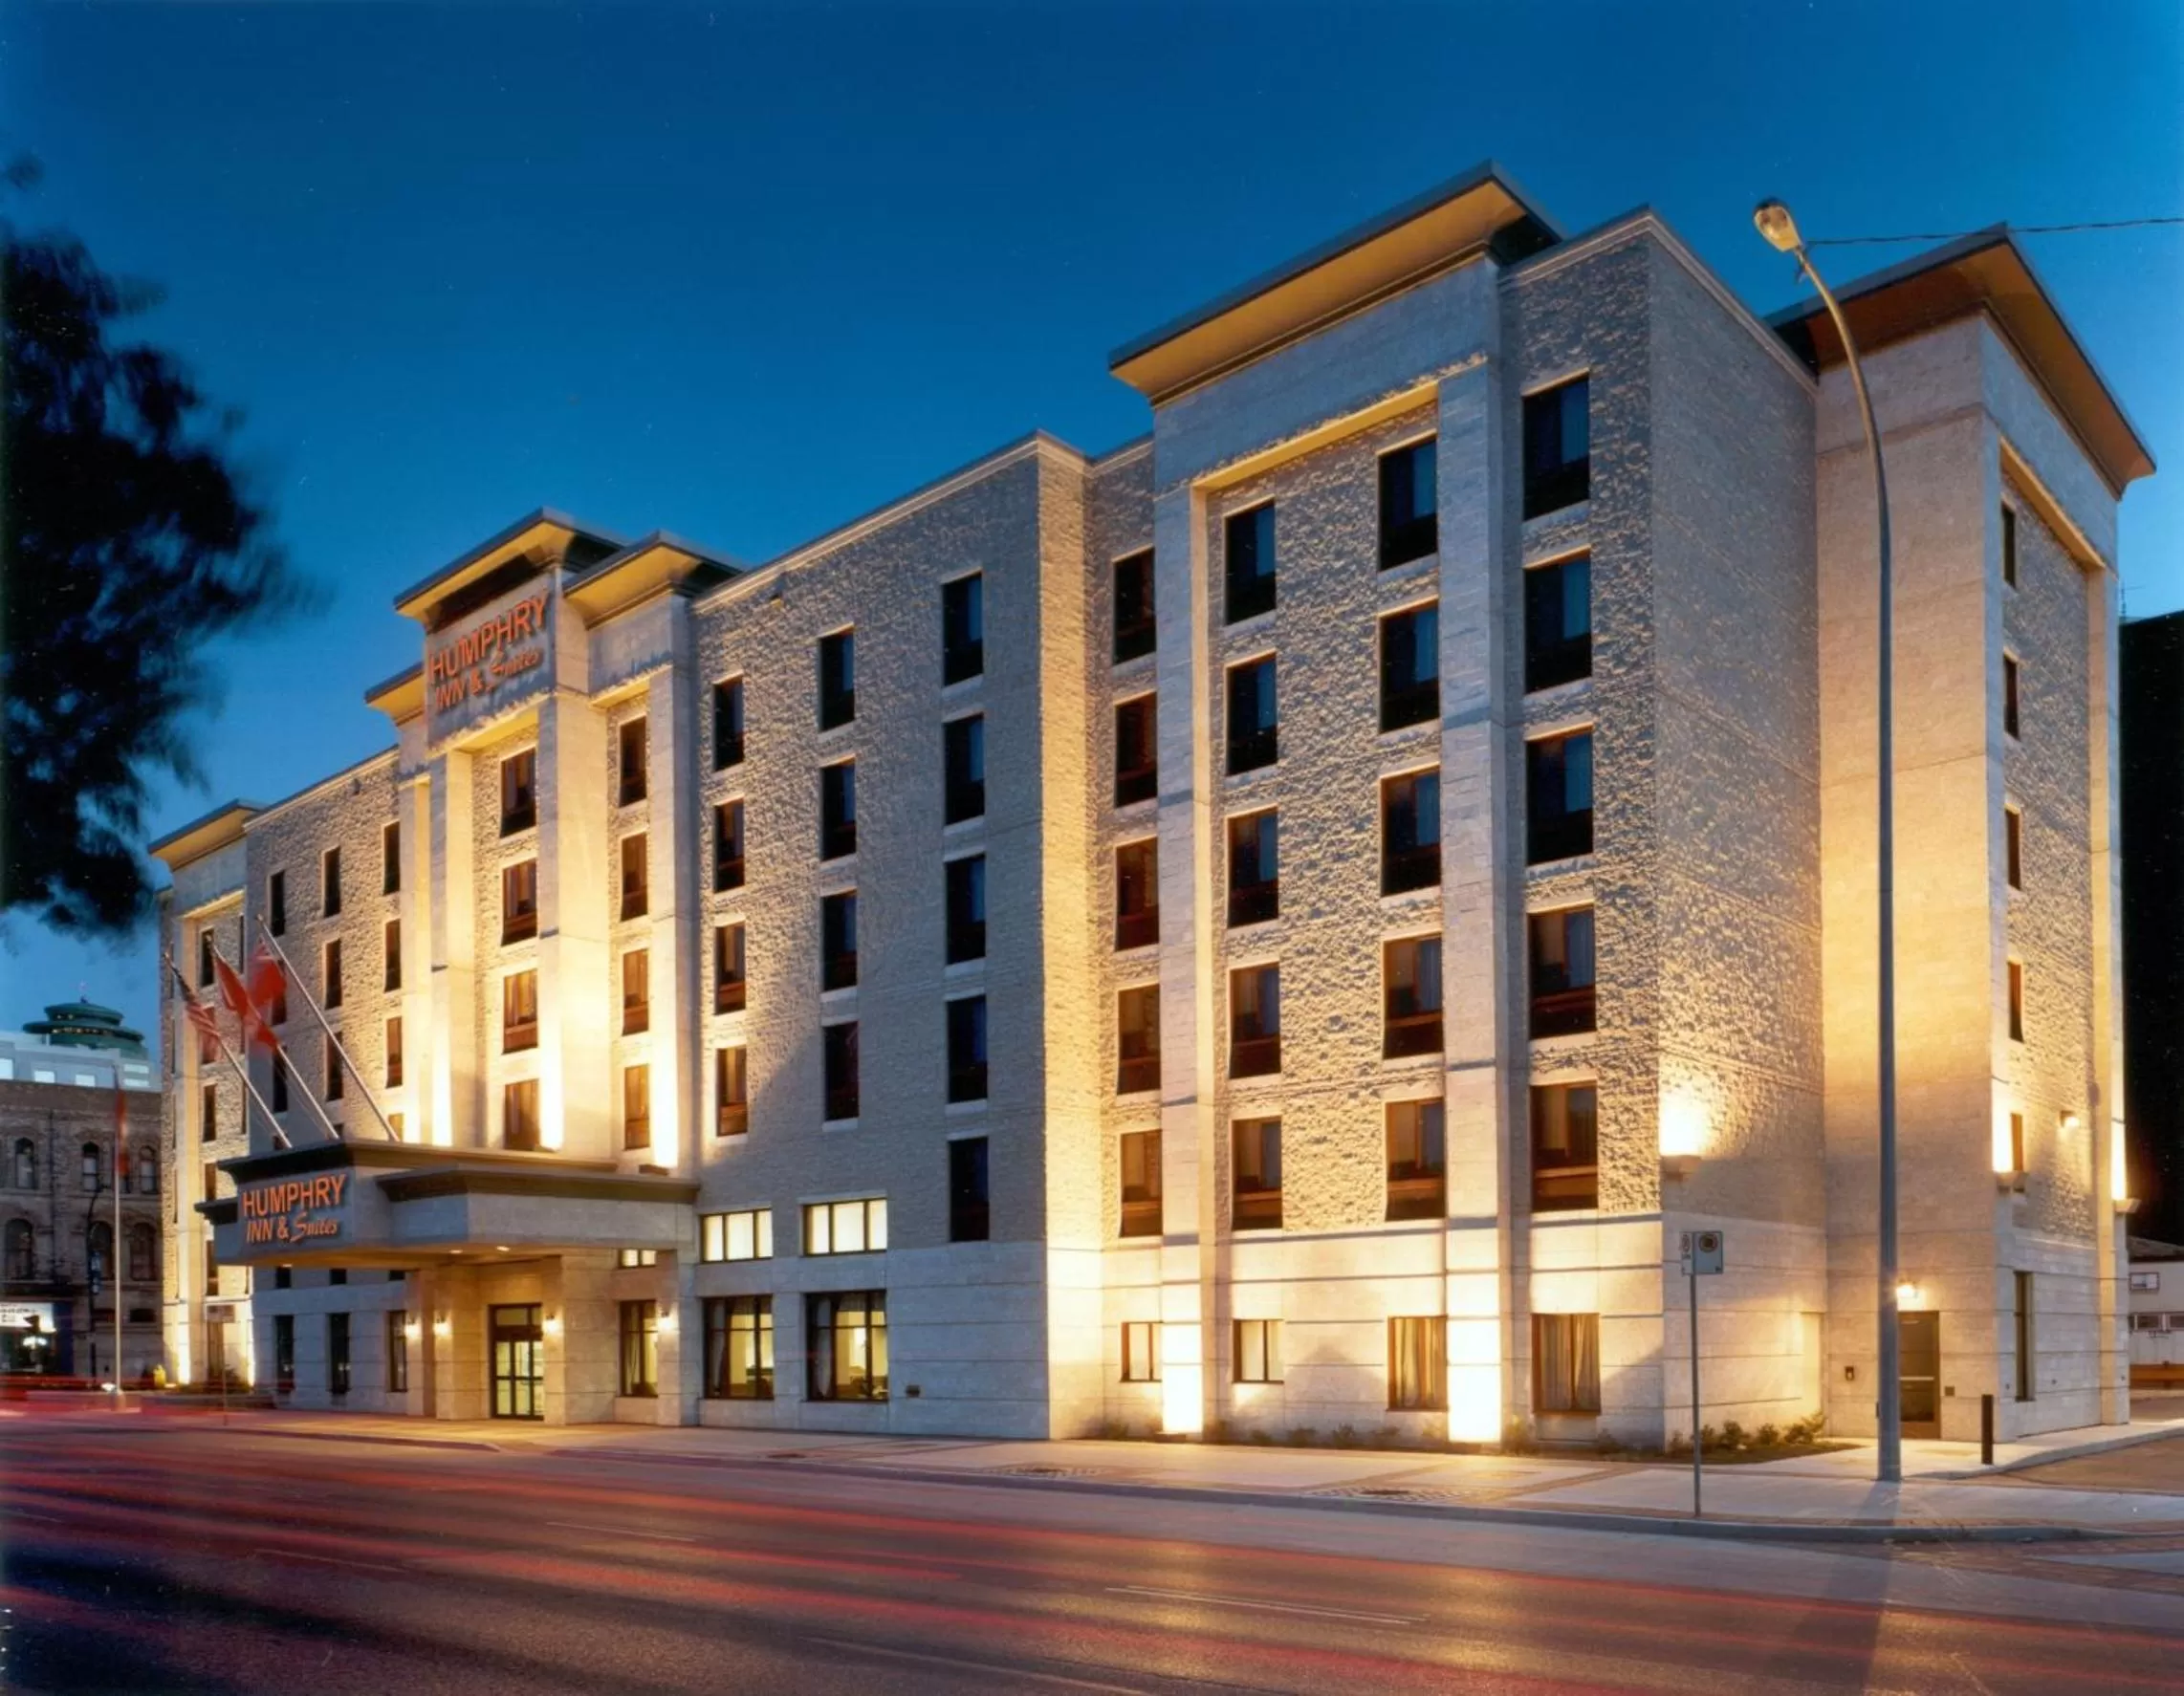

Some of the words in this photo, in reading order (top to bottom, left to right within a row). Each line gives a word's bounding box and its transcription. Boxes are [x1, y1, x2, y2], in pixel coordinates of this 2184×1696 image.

[429, 592, 549, 683] HUMPHRY
[435, 677, 466, 711] INN
[469, 667, 483, 696] &
[243, 1175, 346, 1217] HUMPHRY
[248, 1218, 273, 1242] INN
[277, 1216, 290, 1239] &
